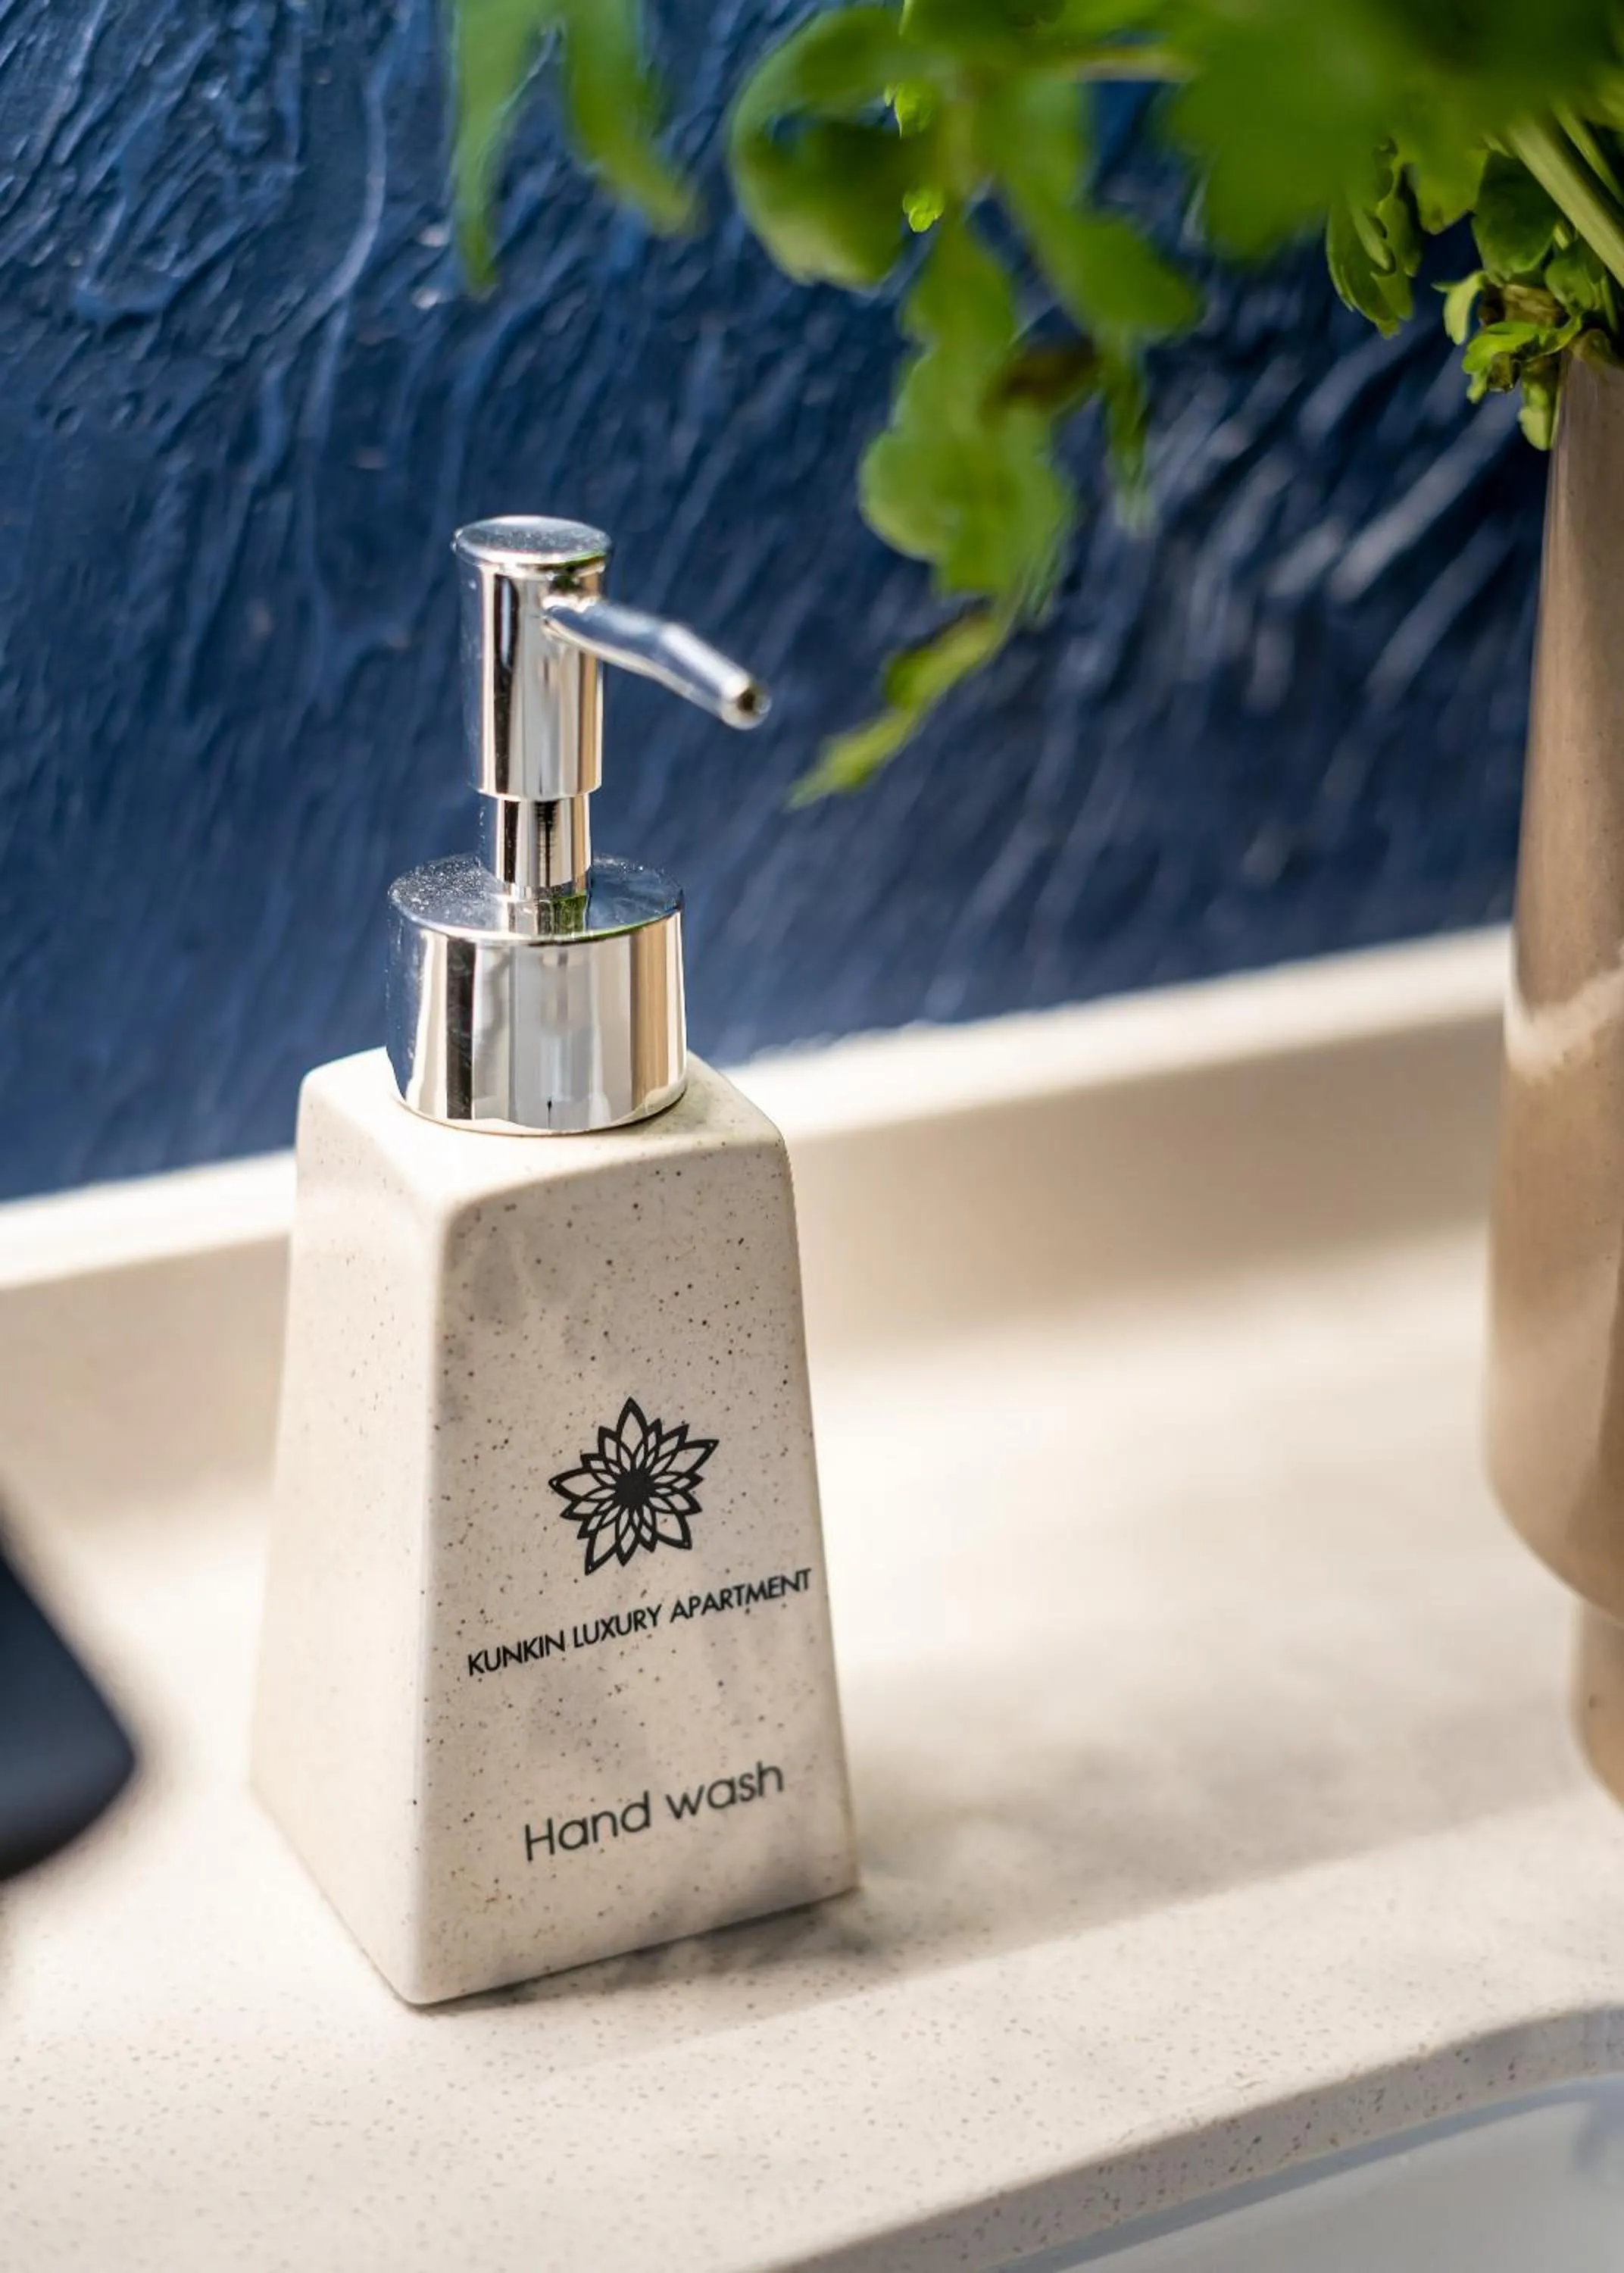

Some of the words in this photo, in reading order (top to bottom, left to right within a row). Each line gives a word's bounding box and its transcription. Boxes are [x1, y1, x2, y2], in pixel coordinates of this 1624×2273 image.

[467, 1630, 566, 1676] KUNKIN
[572, 1604, 663, 1648] LUXURY
[670, 1568, 812, 1623] APARTMENT
[524, 1790, 652, 1862] Hand
[666, 1760, 785, 1819] wash
